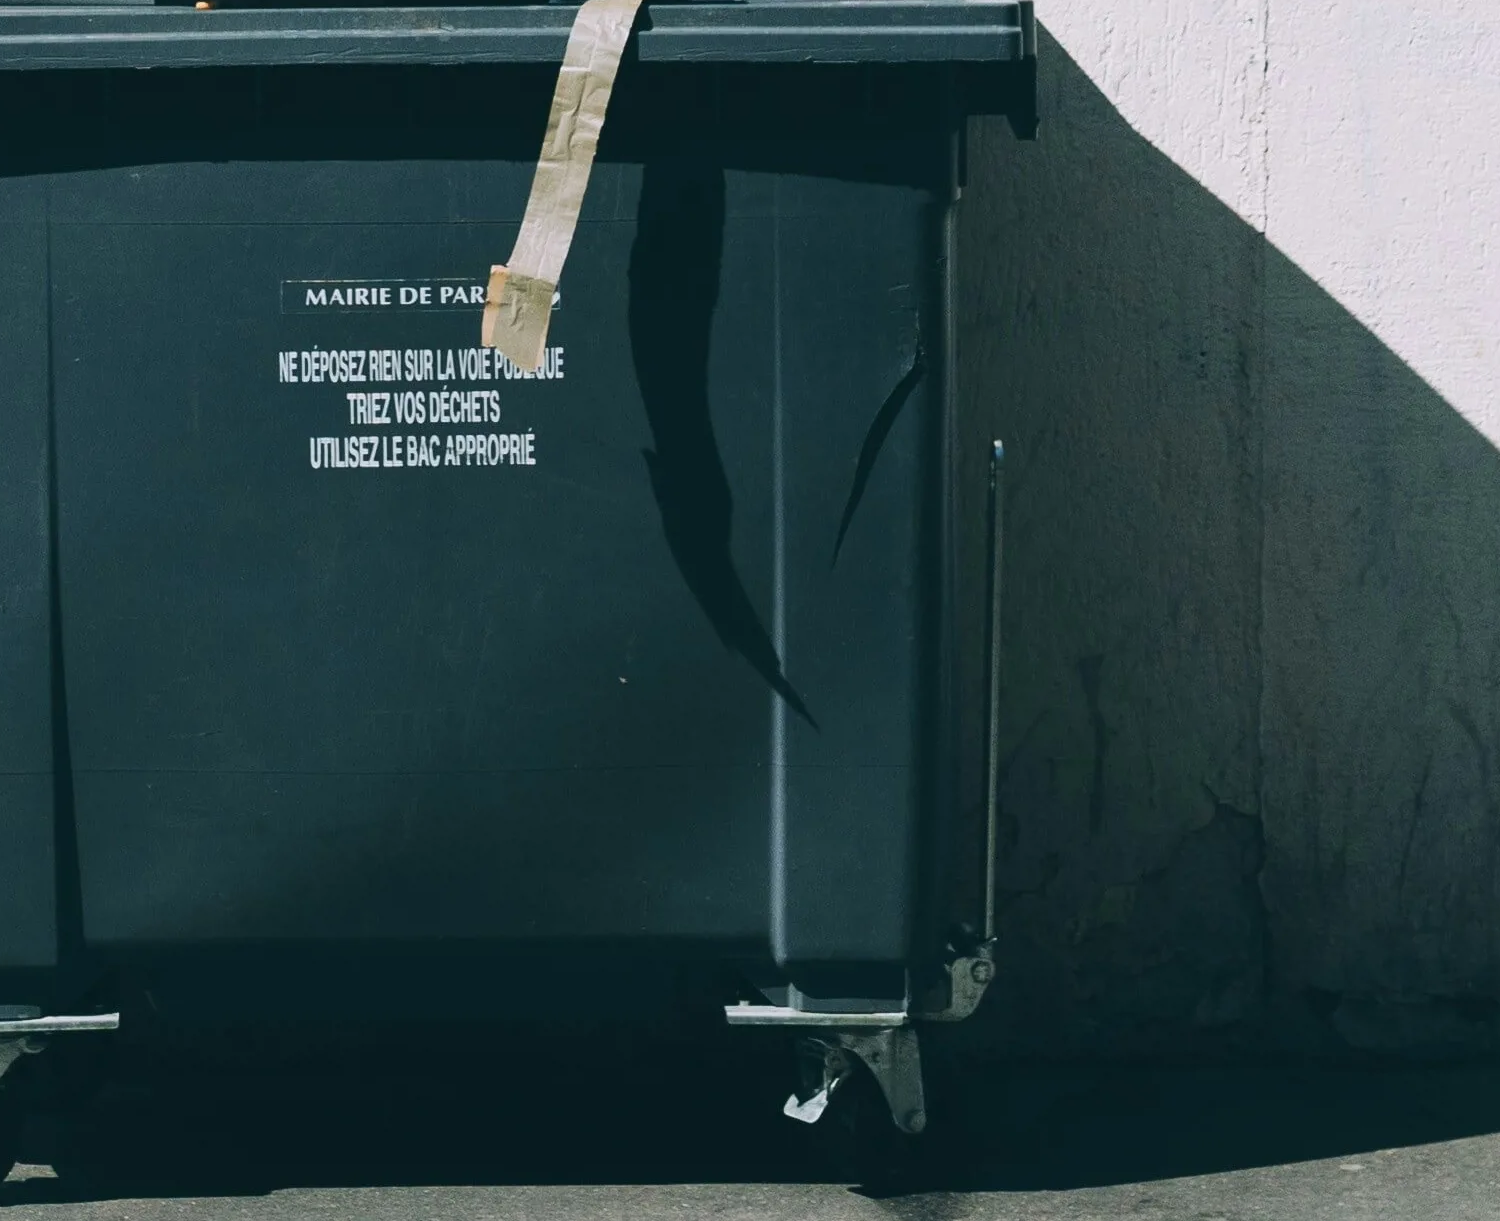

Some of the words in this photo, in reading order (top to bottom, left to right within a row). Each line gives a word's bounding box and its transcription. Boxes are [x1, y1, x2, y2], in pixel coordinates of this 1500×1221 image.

[305, 288, 392, 306] MAIRIE
[399, 287, 432, 305] DE
[440, 286, 487, 304] PAR
[278, 351, 299, 383] NE
[301, 344, 367, 383] DÉPOSEZ
[369, 350, 402, 382] RIEN
[404, 349, 434, 382] SUR
[437, 349, 457, 381] LA
[458, 348, 491, 381] VOIE
[346, 392, 392, 425] TRIEZ
[393, 391, 427, 424] VOS
[429, 385, 501, 423] DÉCHETS
[309, 436, 380, 469] UTILISEZ
[383, 436, 404, 468] LE
[407, 435, 441, 467] BAC
[444, 427, 537, 467] APPROPRIÉ
